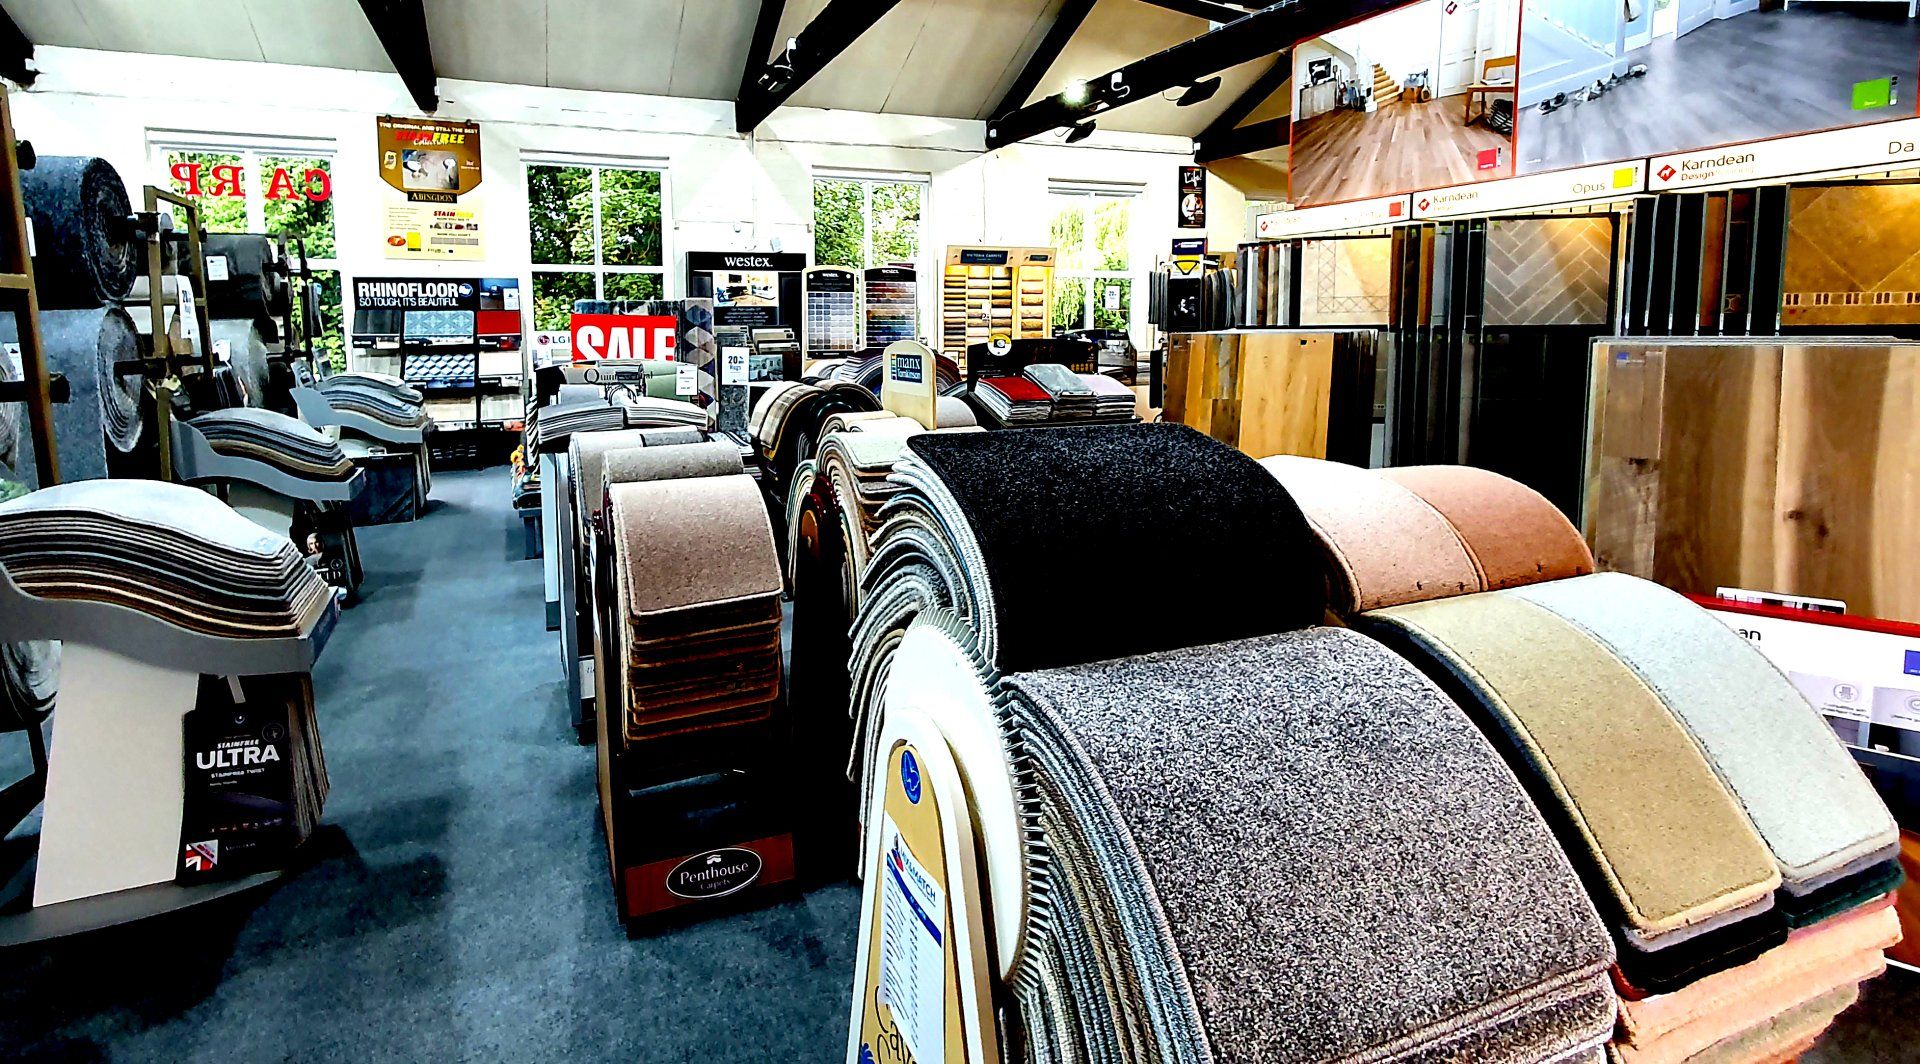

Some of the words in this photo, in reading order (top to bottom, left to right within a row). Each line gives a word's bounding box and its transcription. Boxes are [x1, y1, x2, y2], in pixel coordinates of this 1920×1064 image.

[1888, 141, 1914, 154] Da
[1682, 153, 1755, 171] Karndean
[1572, 181, 1605, 194] Opus
[411, 192, 454, 202] ABINGDON
[1433, 191, 1479, 203] Karndean
[724, 256, 773, 268] westex.
[358, 282, 459, 298] RHINOFLOOR
[359, 297, 372, 307] SO
[403, 297, 417, 307] IT'S
[552, 335, 566, 344] LG
[576, 325, 675, 362] SALE
[728, 355, 738, 364] 20
[897, 357, 920, 369] manx
[196, 744, 280, 769] ULTRA
[680, 862, 749, 885] Penthouse
[700, 879, 731, 890] Carpets
